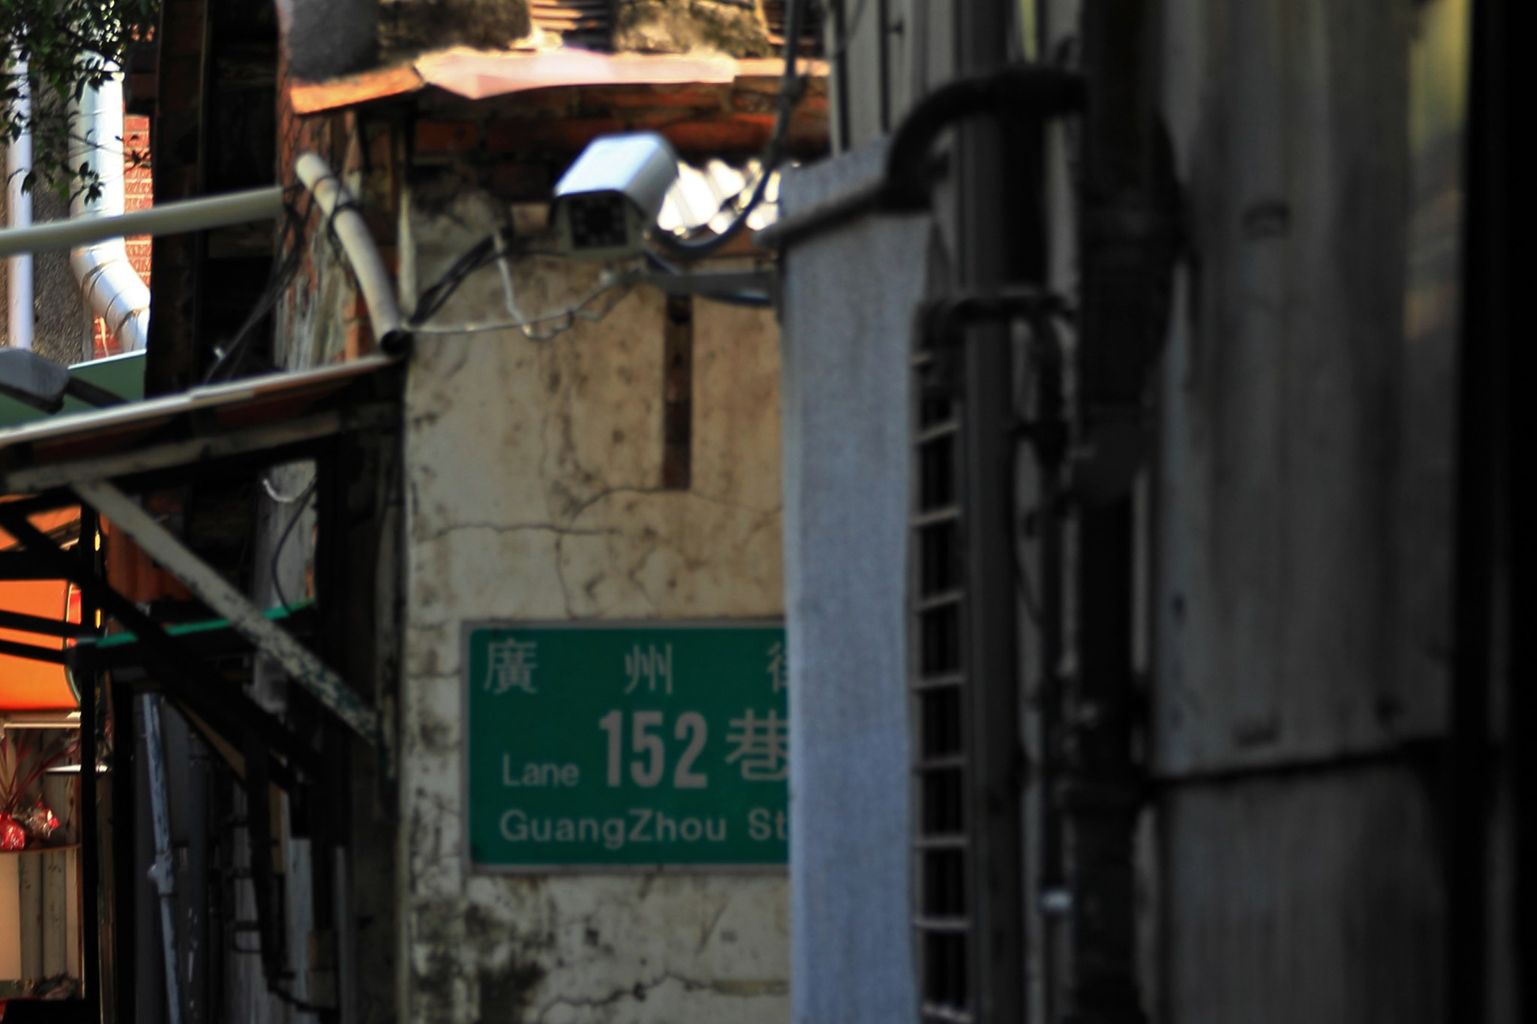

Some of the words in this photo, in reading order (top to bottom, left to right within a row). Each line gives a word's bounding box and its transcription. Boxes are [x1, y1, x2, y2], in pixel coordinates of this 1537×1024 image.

[502, 754, 580, 786] Lane
[598, 708, 708, 789] 152
[499, 808, 727, 850] GuangZhou
